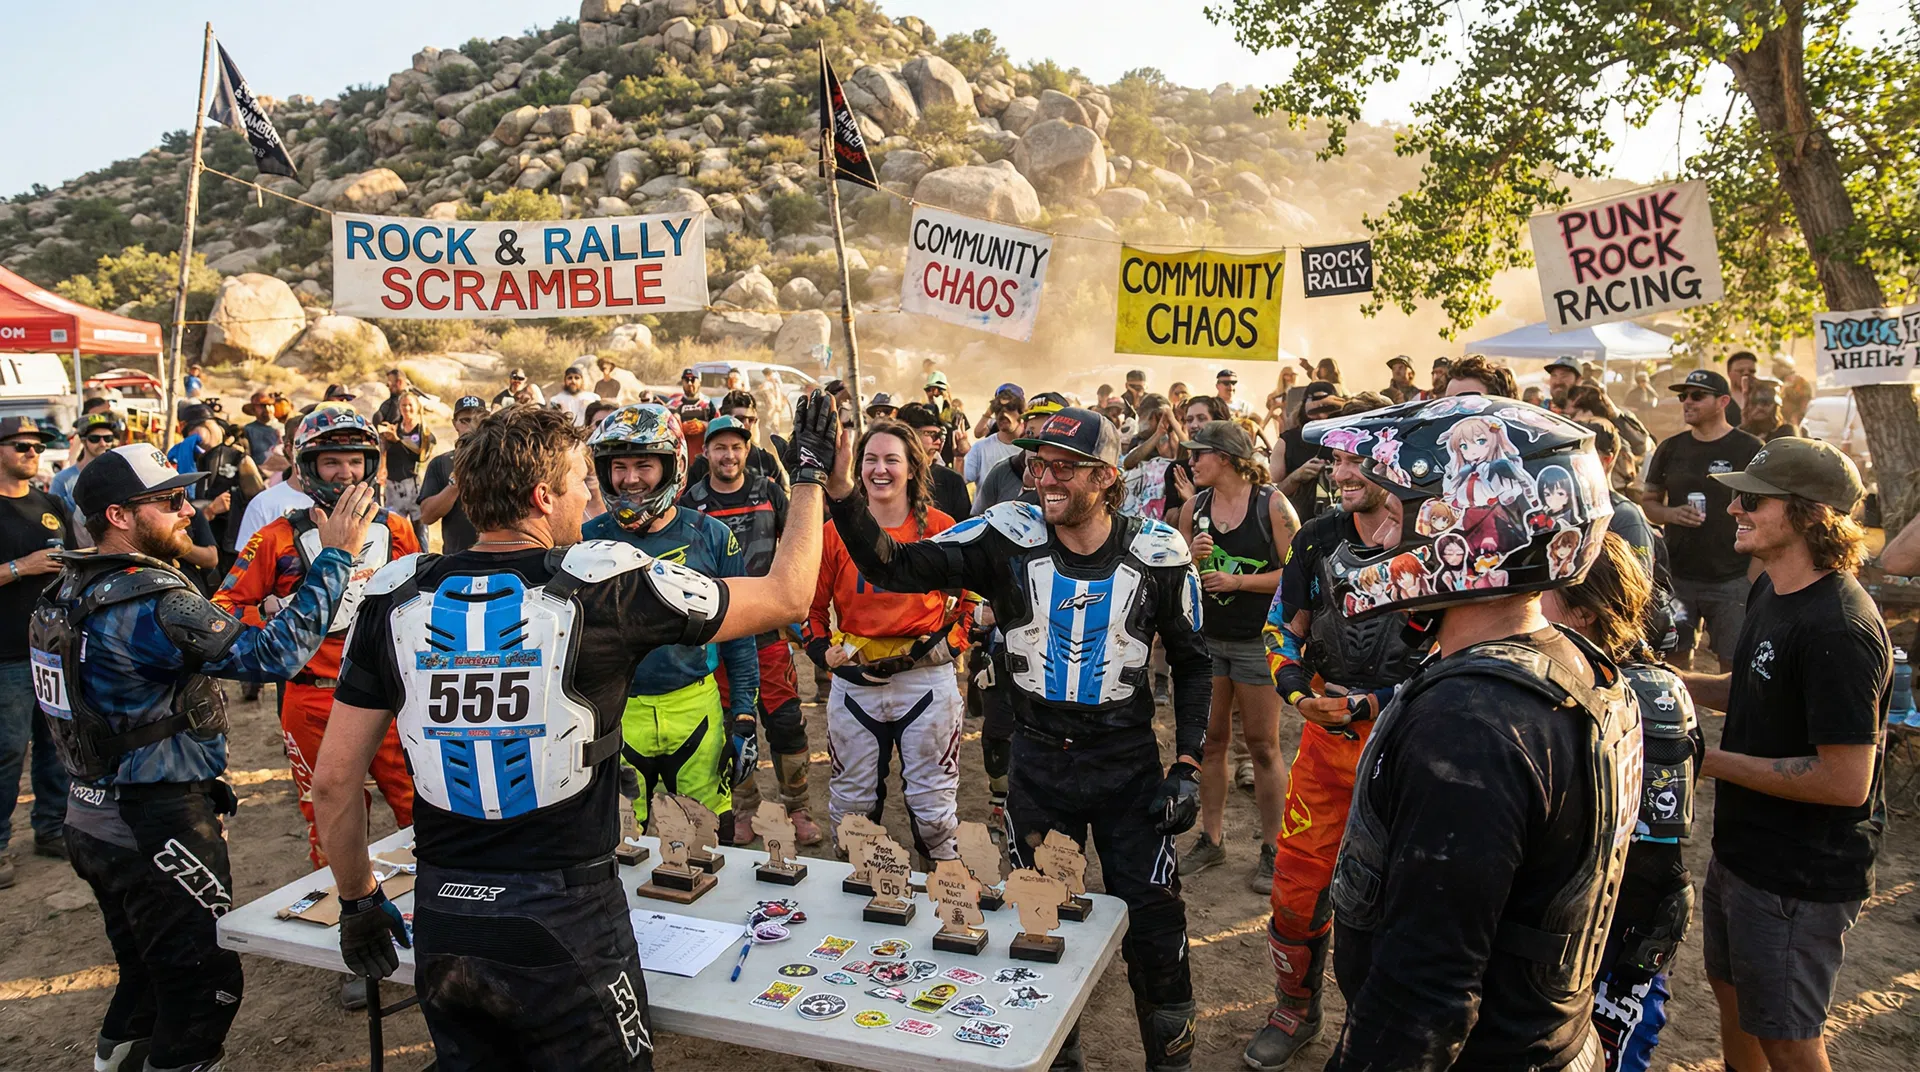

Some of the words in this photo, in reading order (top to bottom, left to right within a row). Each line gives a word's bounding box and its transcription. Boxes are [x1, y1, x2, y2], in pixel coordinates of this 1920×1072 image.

[345, 220, 477, 265] ROCK
[495, 229, 526, 266] &
[544, 218, 692, 265] RALLY
[1557, 190, 1683, 249] PUNK
[913, 218, 1049, 279] COMMUNITY
[1308, 247, 1365, 272] ROCK
[1569, 229, 1685, 284] ROCK
[381, 263, 666, 311] SCRAMBLE
[922, 261, 1019, 318] CHAOS
[1122, 257, 1283, 301] COMMUNITY
[1307, 266, 1370, 291] RALLY
[1554, 264, 1702, 325] RACING
[1146, 303, 1258, 350] CHAOS
[35, 665, 60, 706] 357
[428, 671, 530, 723] 555
